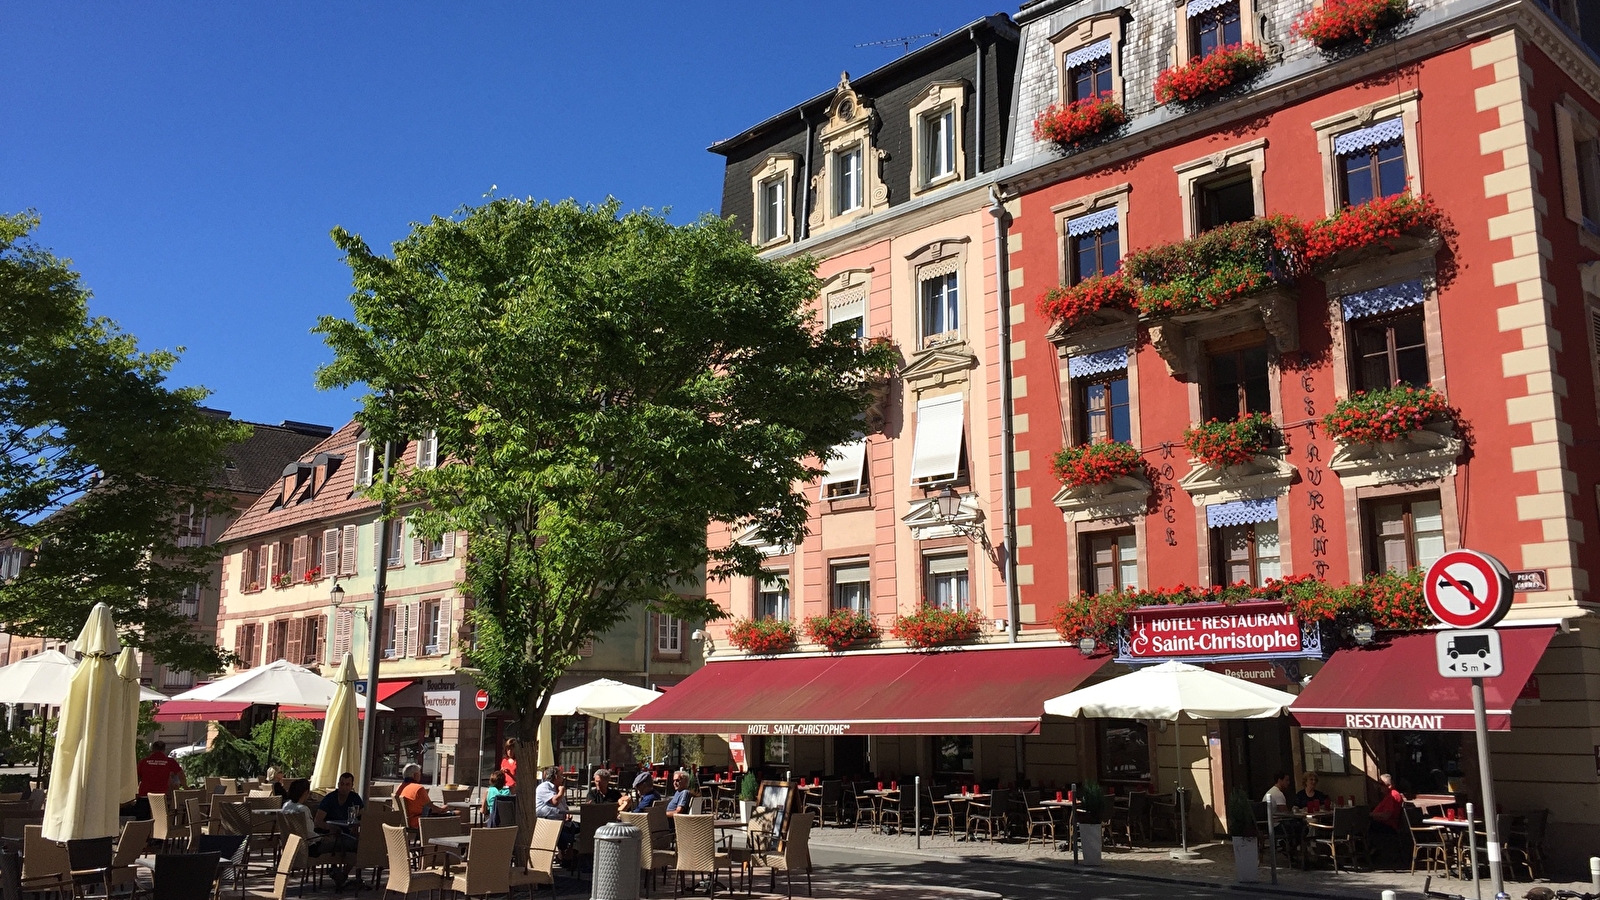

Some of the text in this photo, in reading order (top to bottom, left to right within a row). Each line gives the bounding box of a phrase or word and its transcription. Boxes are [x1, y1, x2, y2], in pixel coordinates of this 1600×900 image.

[1160, 441, 1177, 546] HOTEL
[1152, 613, 1294, 632] HOTEL RESTAURANT
[1152, 631, 1298, 653] Saint-Christophe
[1225, 668, 1275, 679] Restaurant
[1462, 662, 1469, 672] 5
[1345, 714, 1444, 729] RESTAURANT
[631, 724, 646, 733] CAFE
[747, 724, 770, 734] HOTEL
